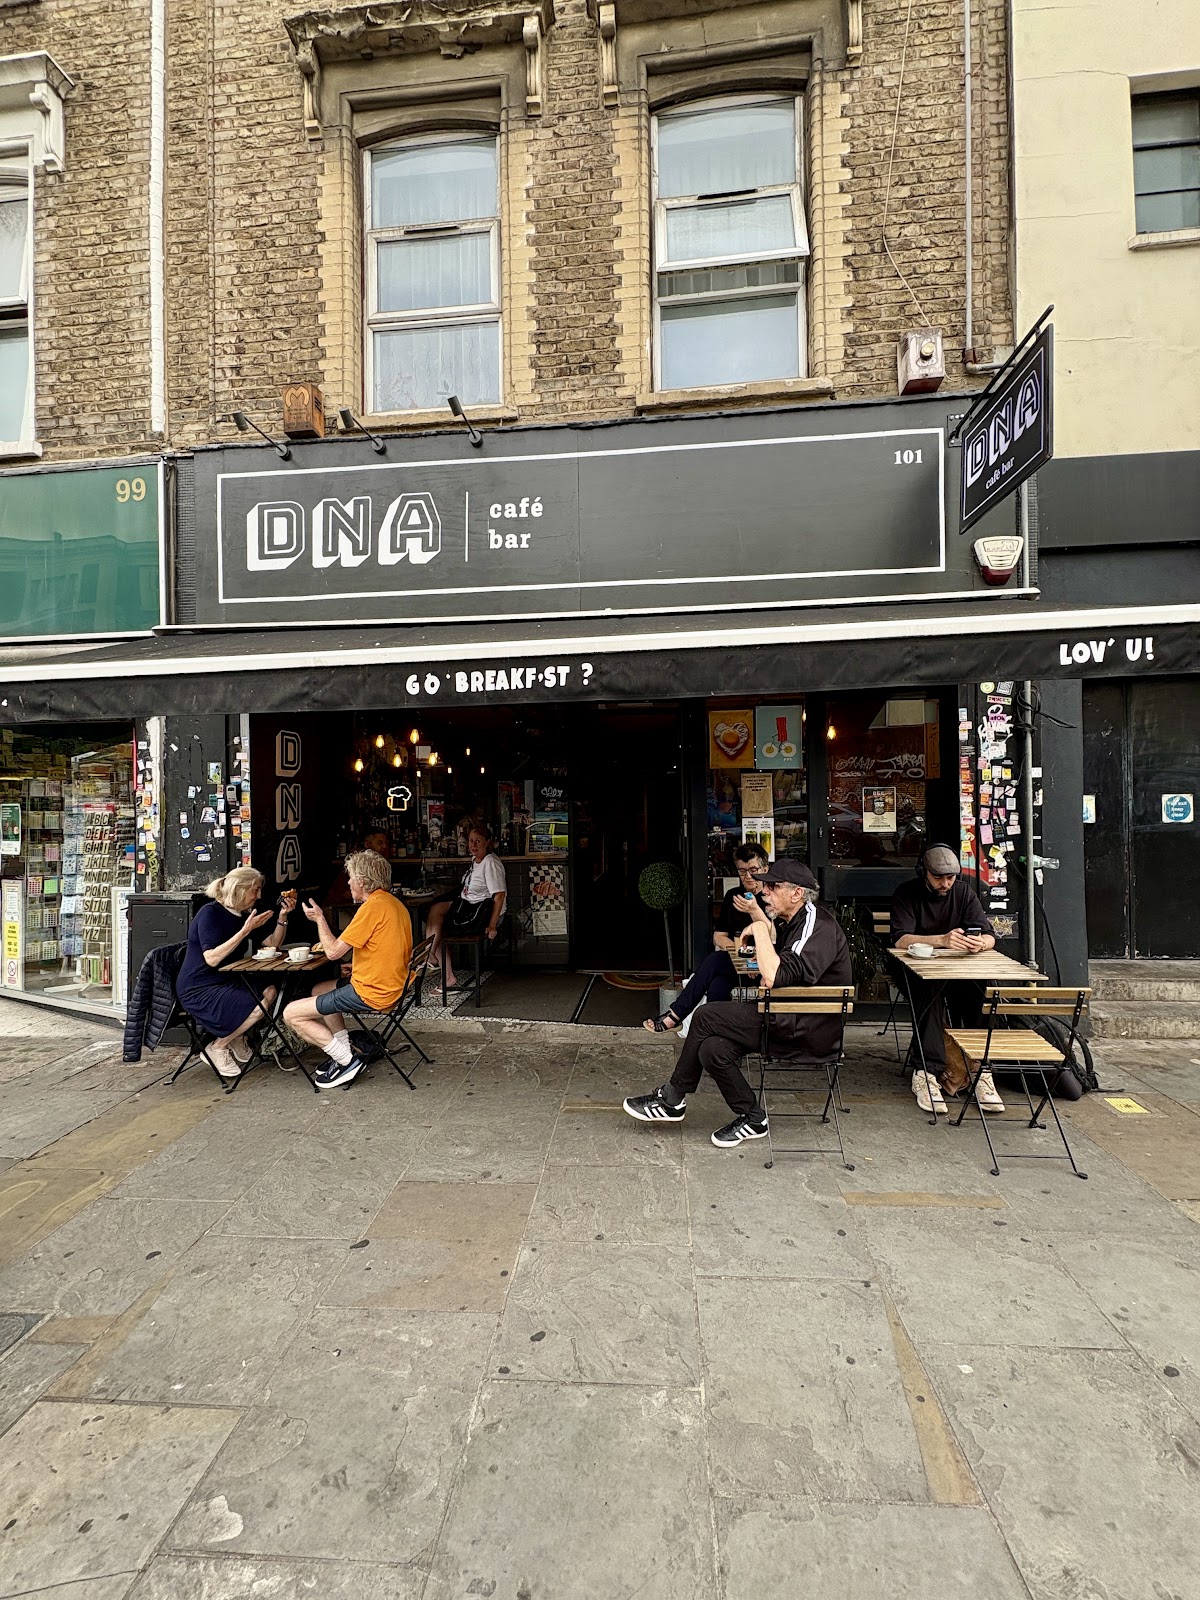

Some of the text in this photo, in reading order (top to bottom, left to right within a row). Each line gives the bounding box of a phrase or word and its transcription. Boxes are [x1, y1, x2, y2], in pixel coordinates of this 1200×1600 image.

[967, 369, 1040, 488] DNA
[893, 450, 923, 465] 101
[1001, 457, 1015, 475] bar
[115, 477, 147, 503] 99
[489, 497, 544, 518] café
[246, 491, 442, 572] DNA
[488, 529, 532, 549] bar
[1125, 637, 1155, 662] U!
[275, 730, 302, 884] DNA
